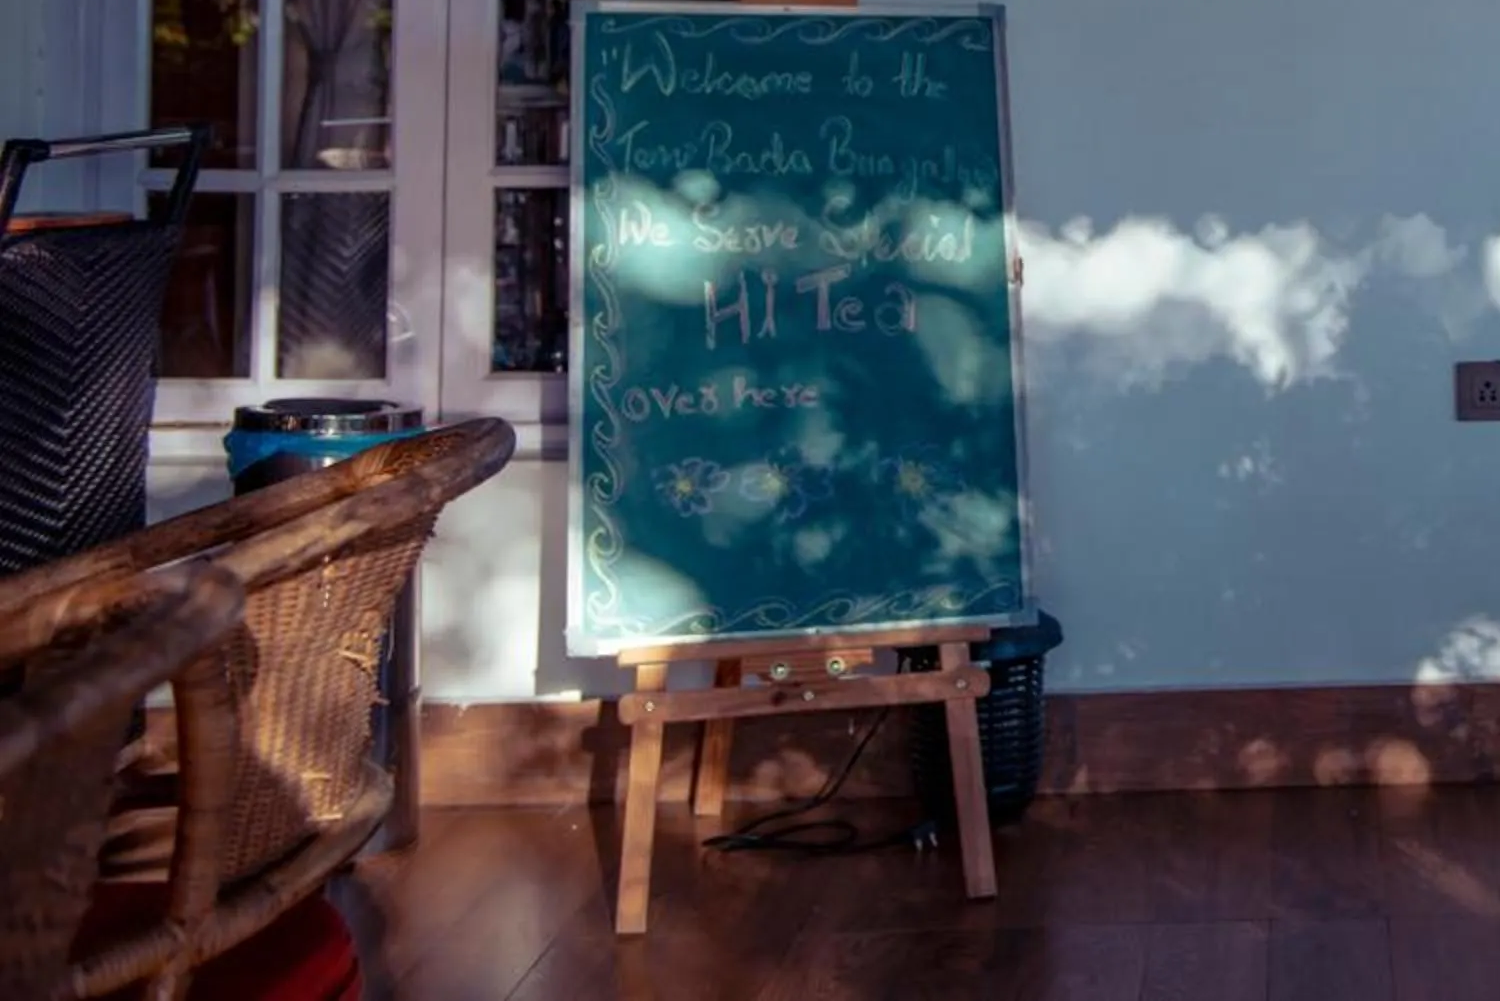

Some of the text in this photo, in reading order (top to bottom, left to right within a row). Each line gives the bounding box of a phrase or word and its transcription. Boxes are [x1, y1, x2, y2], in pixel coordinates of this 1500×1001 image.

[841, 51, 874, 97] to
[894, 53, 948, 98] the
[619, 201, 673, 247] We
[796, 263, 917, 336] Tea
